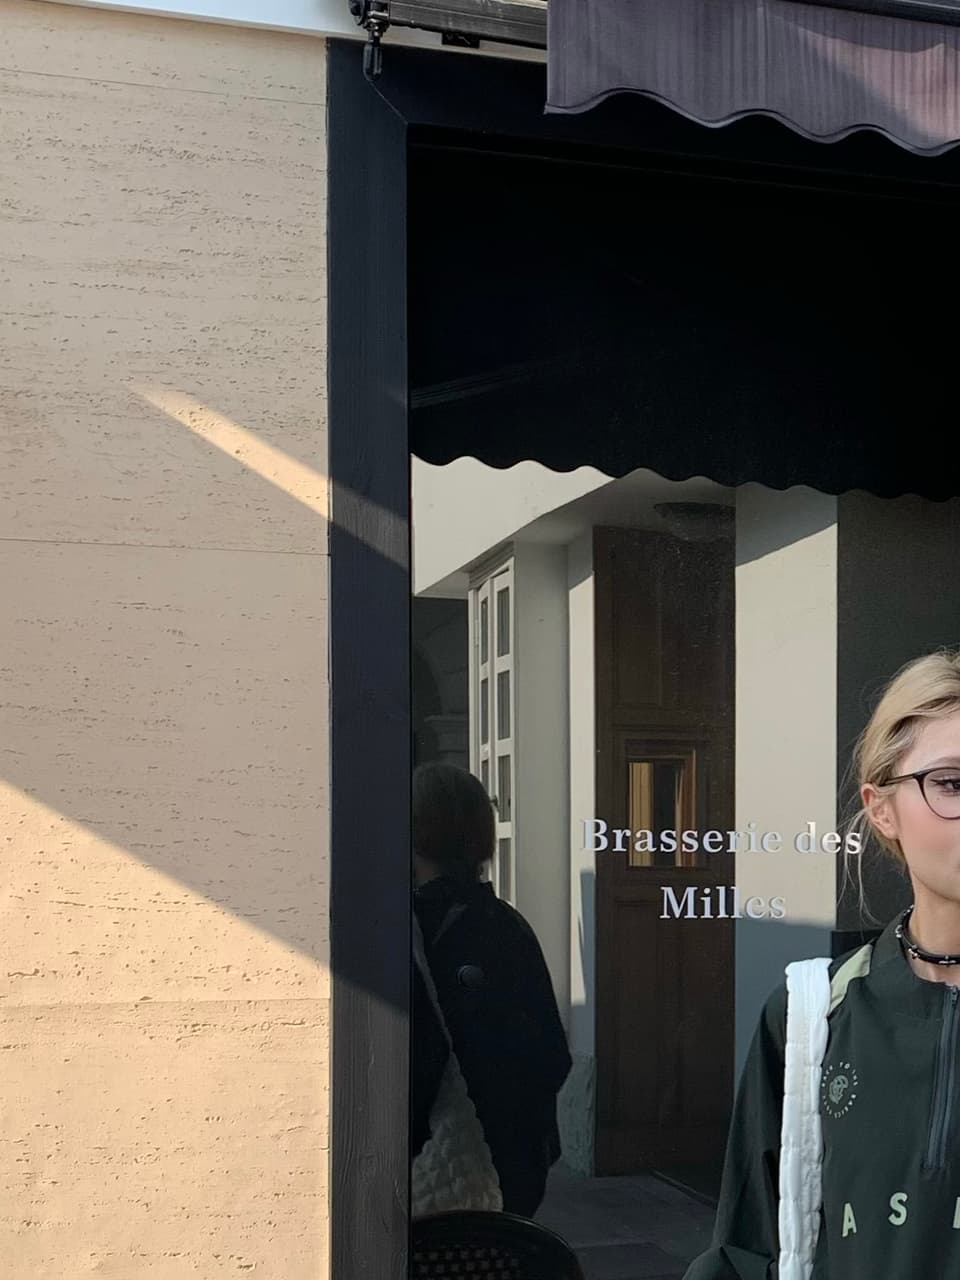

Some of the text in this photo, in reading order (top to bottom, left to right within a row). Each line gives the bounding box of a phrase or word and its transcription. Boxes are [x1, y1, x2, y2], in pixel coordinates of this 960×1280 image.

[580, 818, 862, 854] Brasserie des
[659, 886, 786, 919] Milles
